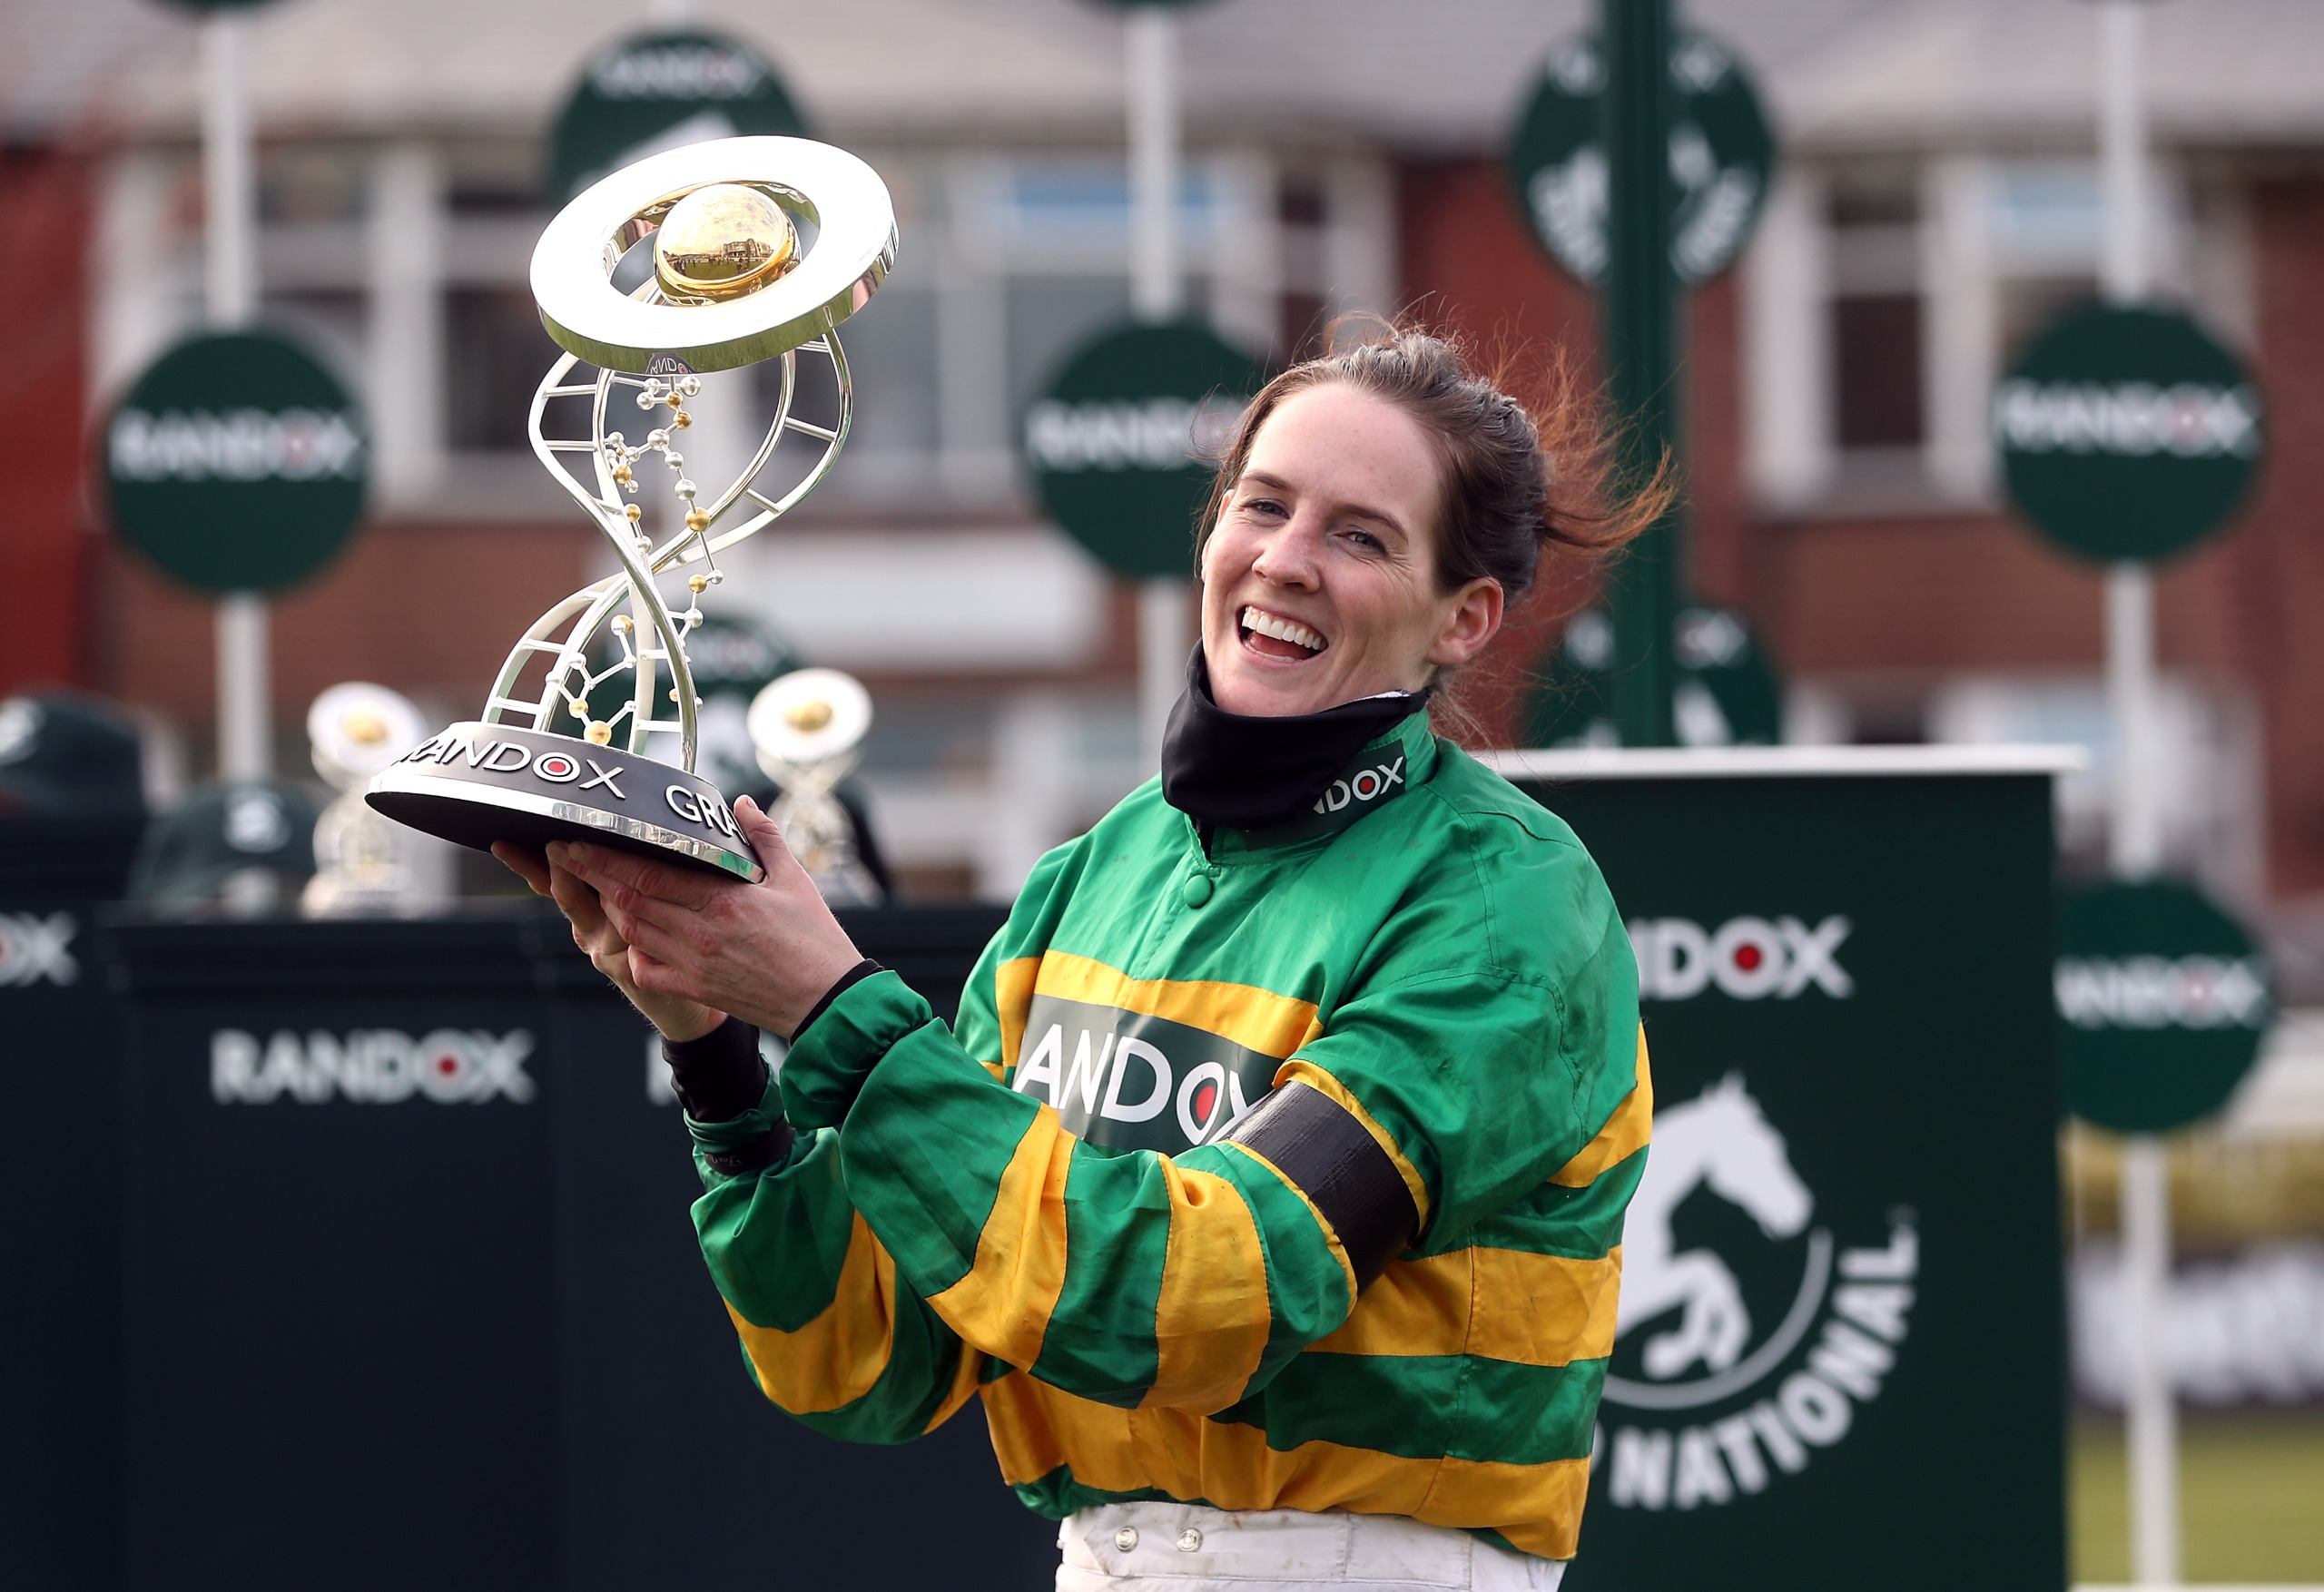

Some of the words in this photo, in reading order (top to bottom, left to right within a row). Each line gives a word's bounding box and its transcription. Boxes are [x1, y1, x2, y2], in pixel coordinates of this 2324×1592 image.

[665, 784, 750, 846] GRA
[1314, 755, 1404, 814] DOX
[211, 1028, 535, 1105] RANDOX
[1012, 1024, 1272, 1145] ANDOX
[1609, 1228, 1919, 1510] NATIONAL
